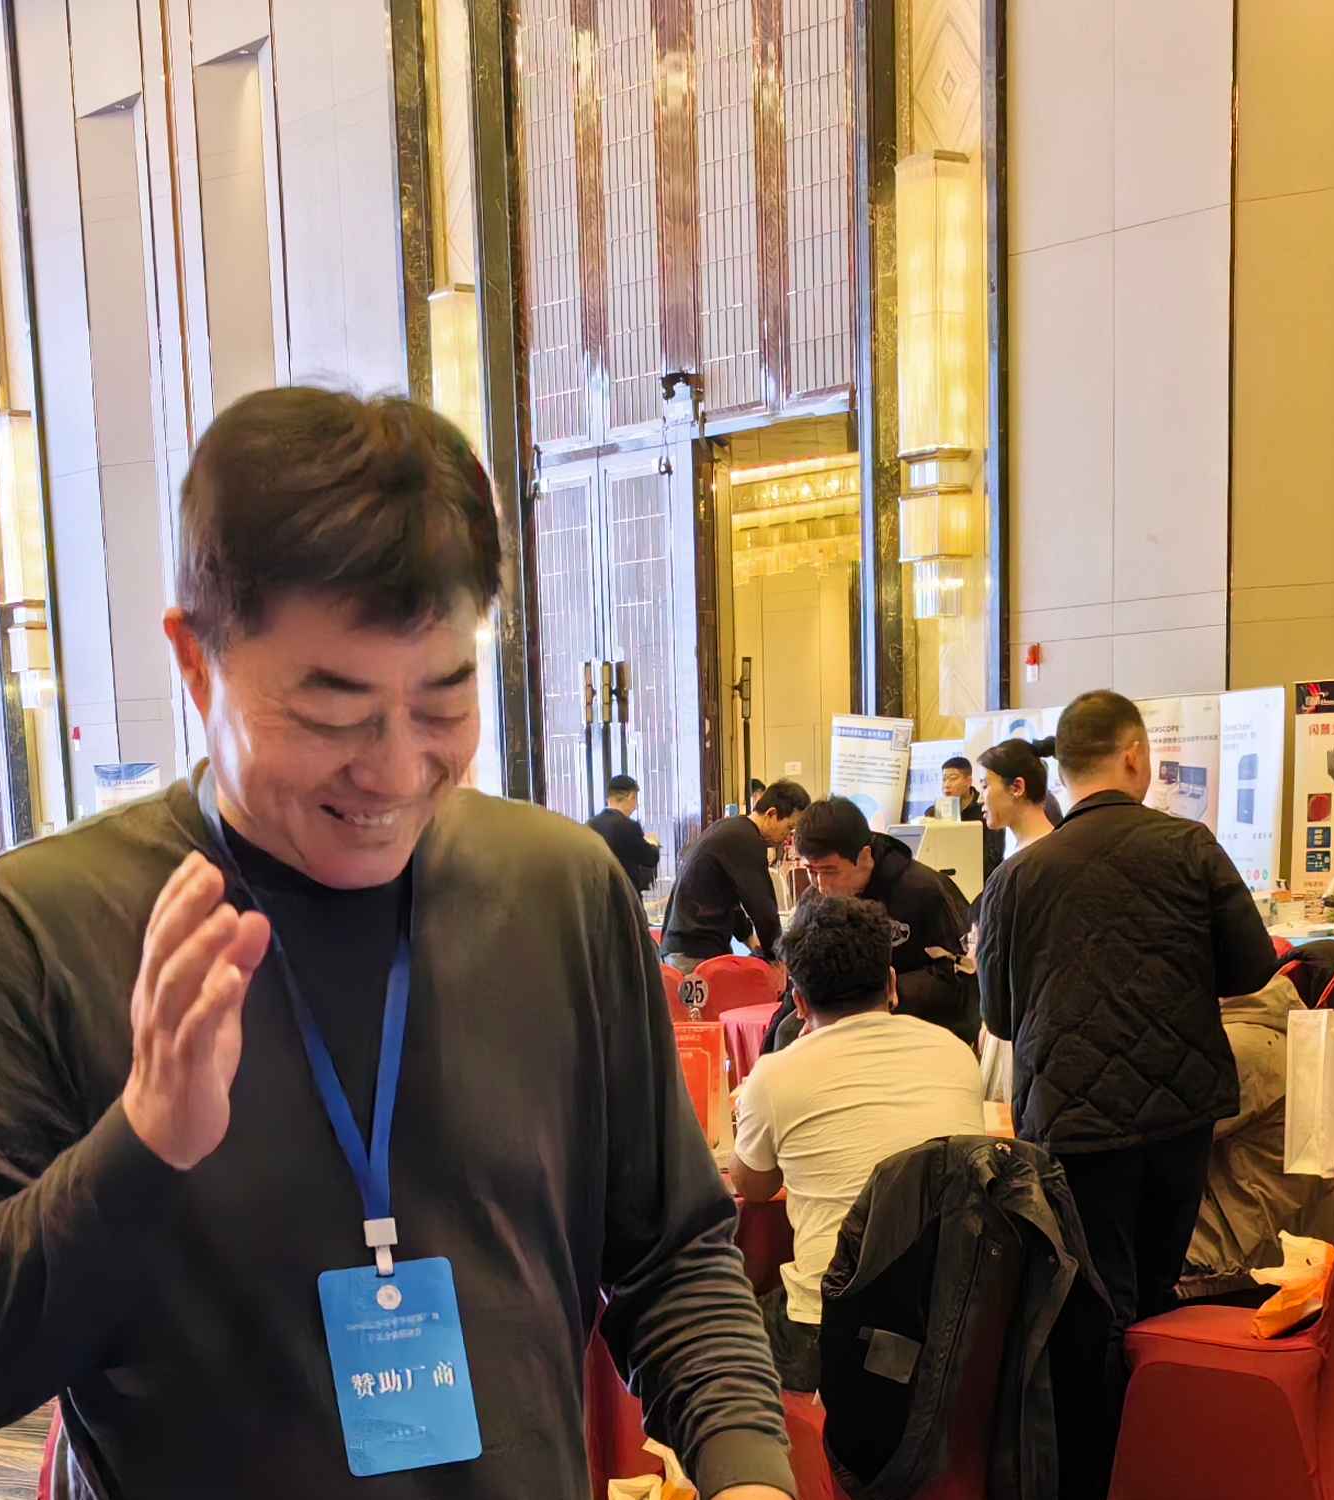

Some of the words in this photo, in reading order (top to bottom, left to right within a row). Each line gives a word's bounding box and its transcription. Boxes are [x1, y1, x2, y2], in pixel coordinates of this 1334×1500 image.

[684, 980, 705, 1004] 25
[351, 1360, 455, 1400] 赞助厂商
